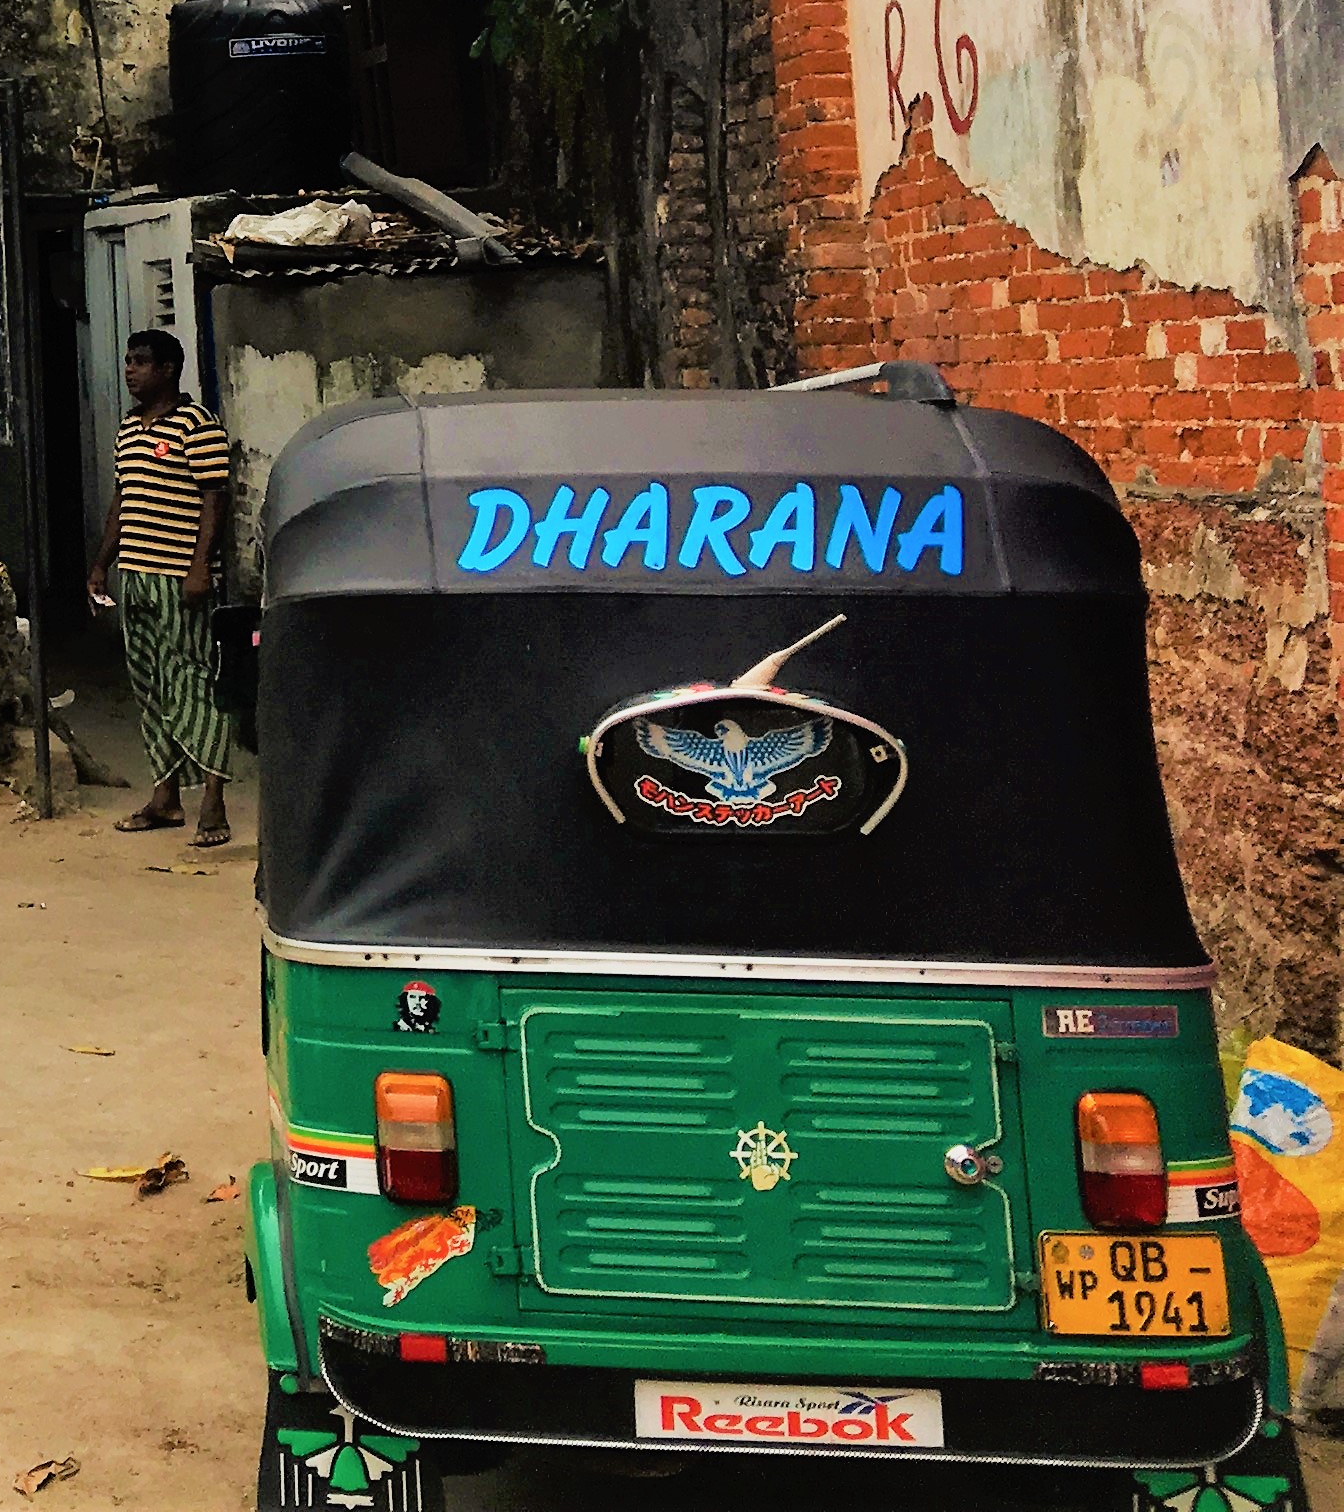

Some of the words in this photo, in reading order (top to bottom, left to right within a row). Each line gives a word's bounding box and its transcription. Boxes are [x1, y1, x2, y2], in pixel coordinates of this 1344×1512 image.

[457, 482, 964, 575] DHARANA
[289, 1153, 339, 1180] Sport
[1109, 1240, 1168, 1283] QB
[1056, 1270, 1098, 1300] WP
[1107, 1290, 1209, 1332] 1941
[660, 1394, 916, 1442] Reebok
[795, 1397, 840, 1411] Sport
